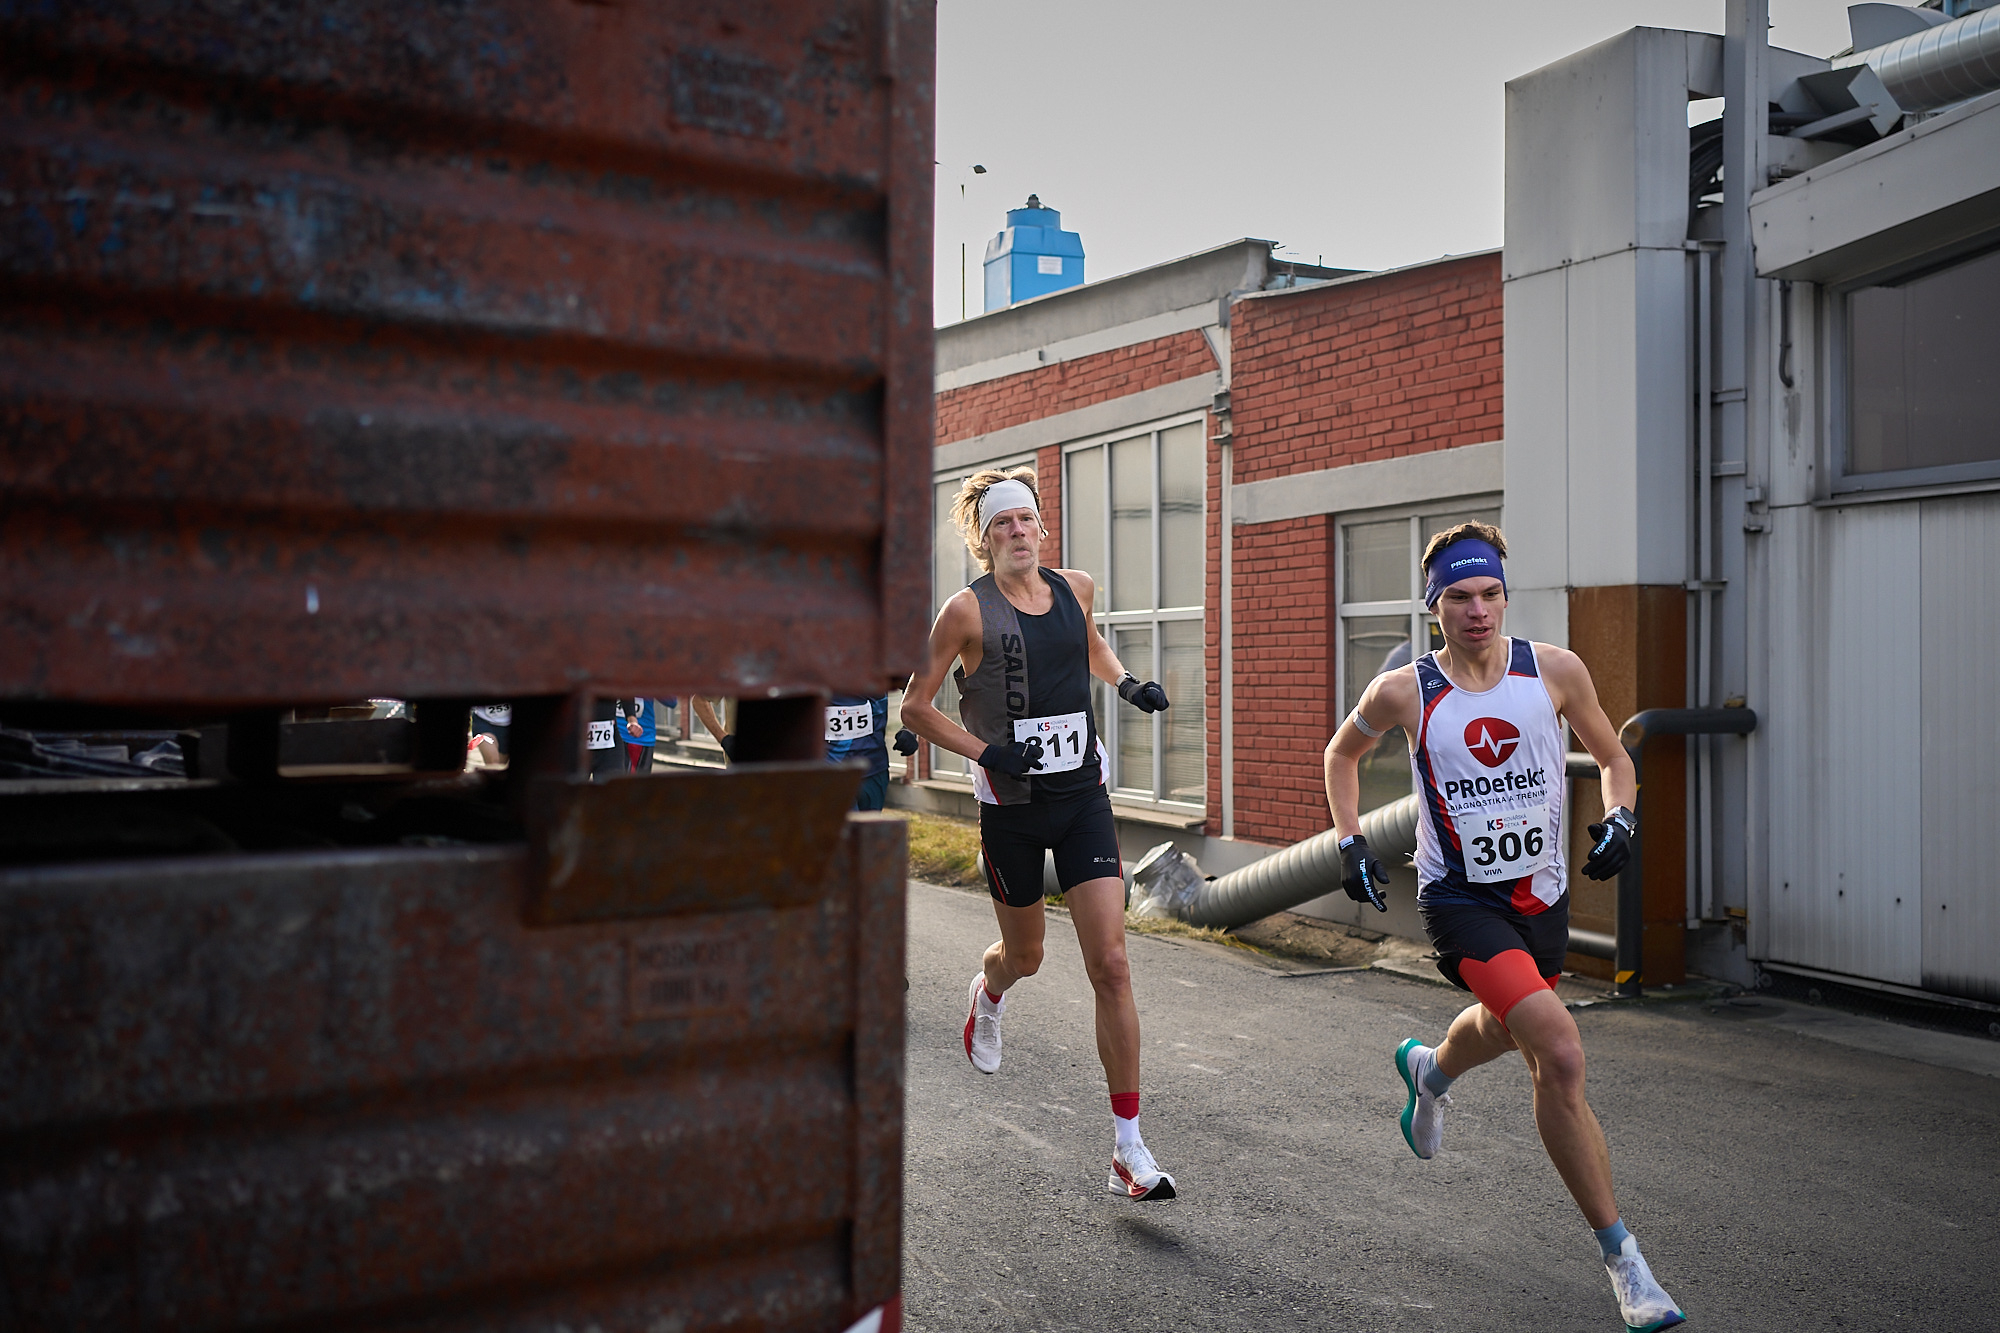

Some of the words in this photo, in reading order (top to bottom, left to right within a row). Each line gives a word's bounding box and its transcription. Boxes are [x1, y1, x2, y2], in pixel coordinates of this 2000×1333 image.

[1451, 557, 1488, 569] PROefekt
[1001, 633, 1026, 744] SALO
[488, 703, 510, 714] 253
[829, 714, 868, 732] 315
[1037, 722, 1051, 732] K5
[587, 729, 611, 743] 476
[1444, 767, 1546, 801] PROefekt
[1508, 795, 1515, 803] A
[1516, 788, 1548, 800] TRÉNIN
[1486, 818, 1504, 831] K5
[1472, 827, 1543, 866] 306
[1359, 857, 1384, 911] TOP4RUNNING
